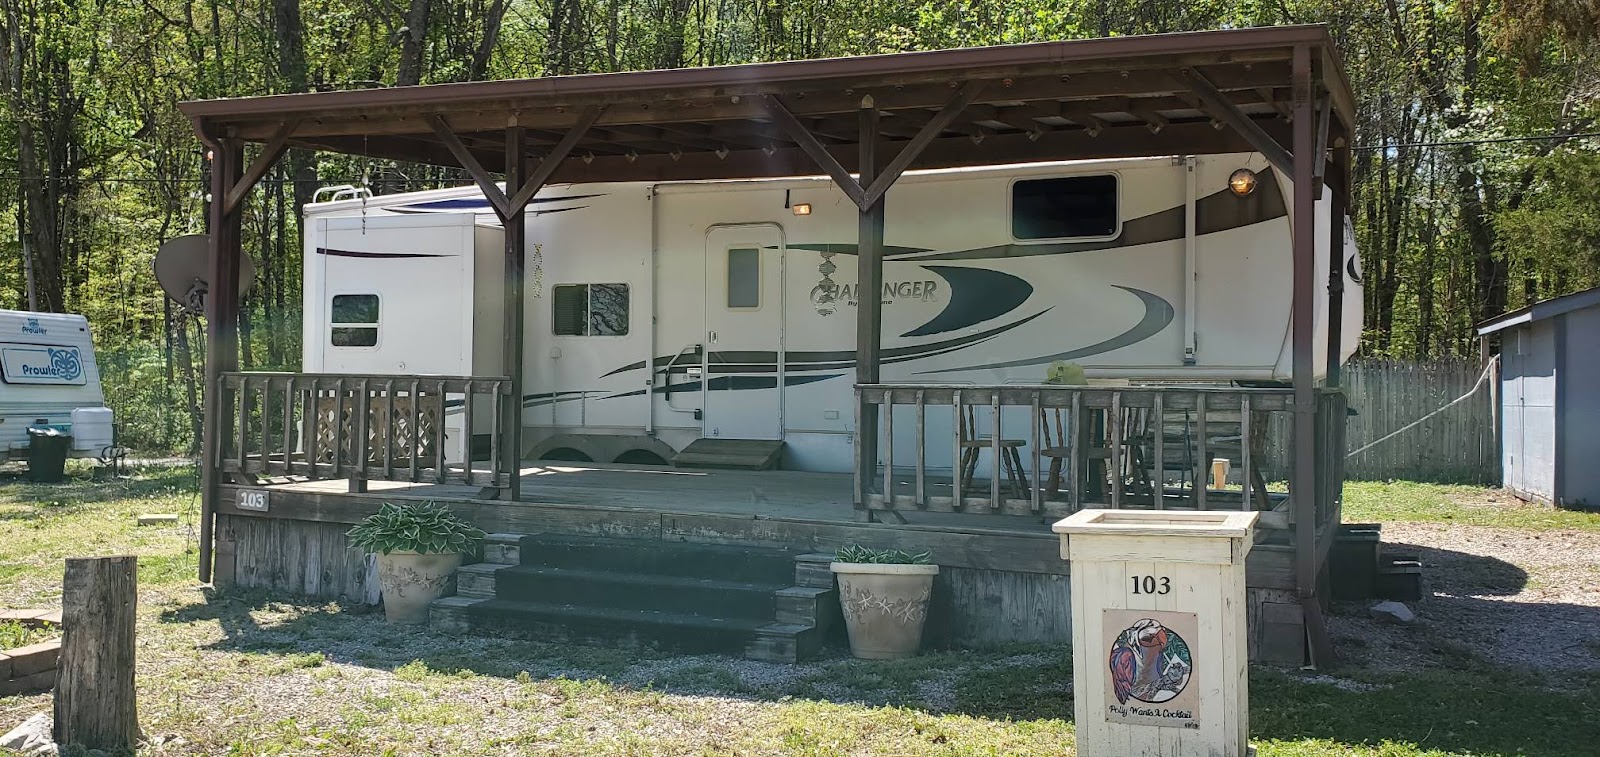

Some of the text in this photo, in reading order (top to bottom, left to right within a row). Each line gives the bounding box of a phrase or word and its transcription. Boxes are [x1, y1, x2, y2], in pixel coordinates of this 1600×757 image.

[21, 326, 47, 335] Prowler
[22, 364, 60, 376] Prowler
[240, 492, 264, 508] 103
[1131, 575, 1171, 595] 103
[1109, 705, 1192, 718] Polly Wants A Cocktail
